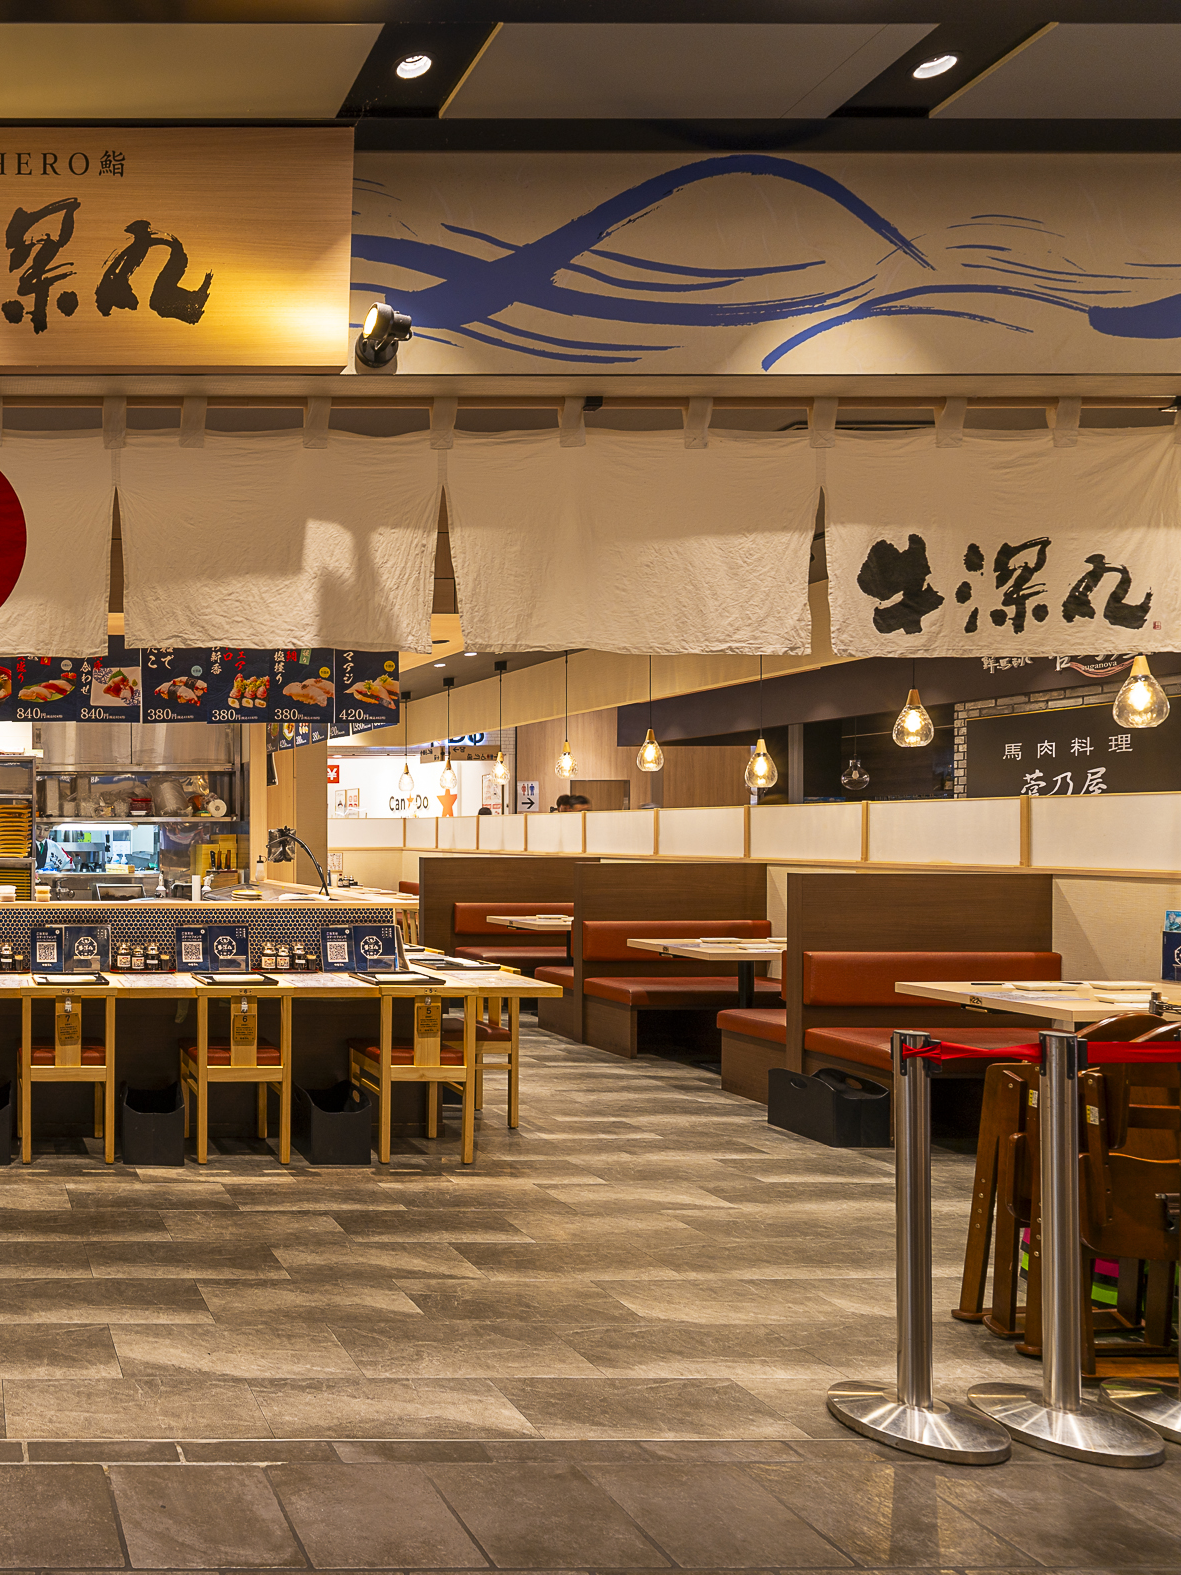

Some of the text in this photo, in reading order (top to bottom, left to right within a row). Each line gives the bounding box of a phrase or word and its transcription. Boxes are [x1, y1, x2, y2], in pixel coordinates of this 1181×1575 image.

[857, 533, 1152, 635] 牛深丸
[343, 651, 354, 684] マアジ
[1003, 733, 1133, 761] 馬肉料理
[1021, 767, 1107, 796] 菅乃屋
[389, 795, 405, 811] Can
[242, 1015, 248, 1023] 6
[426, 1007, 432, 1015] 5
